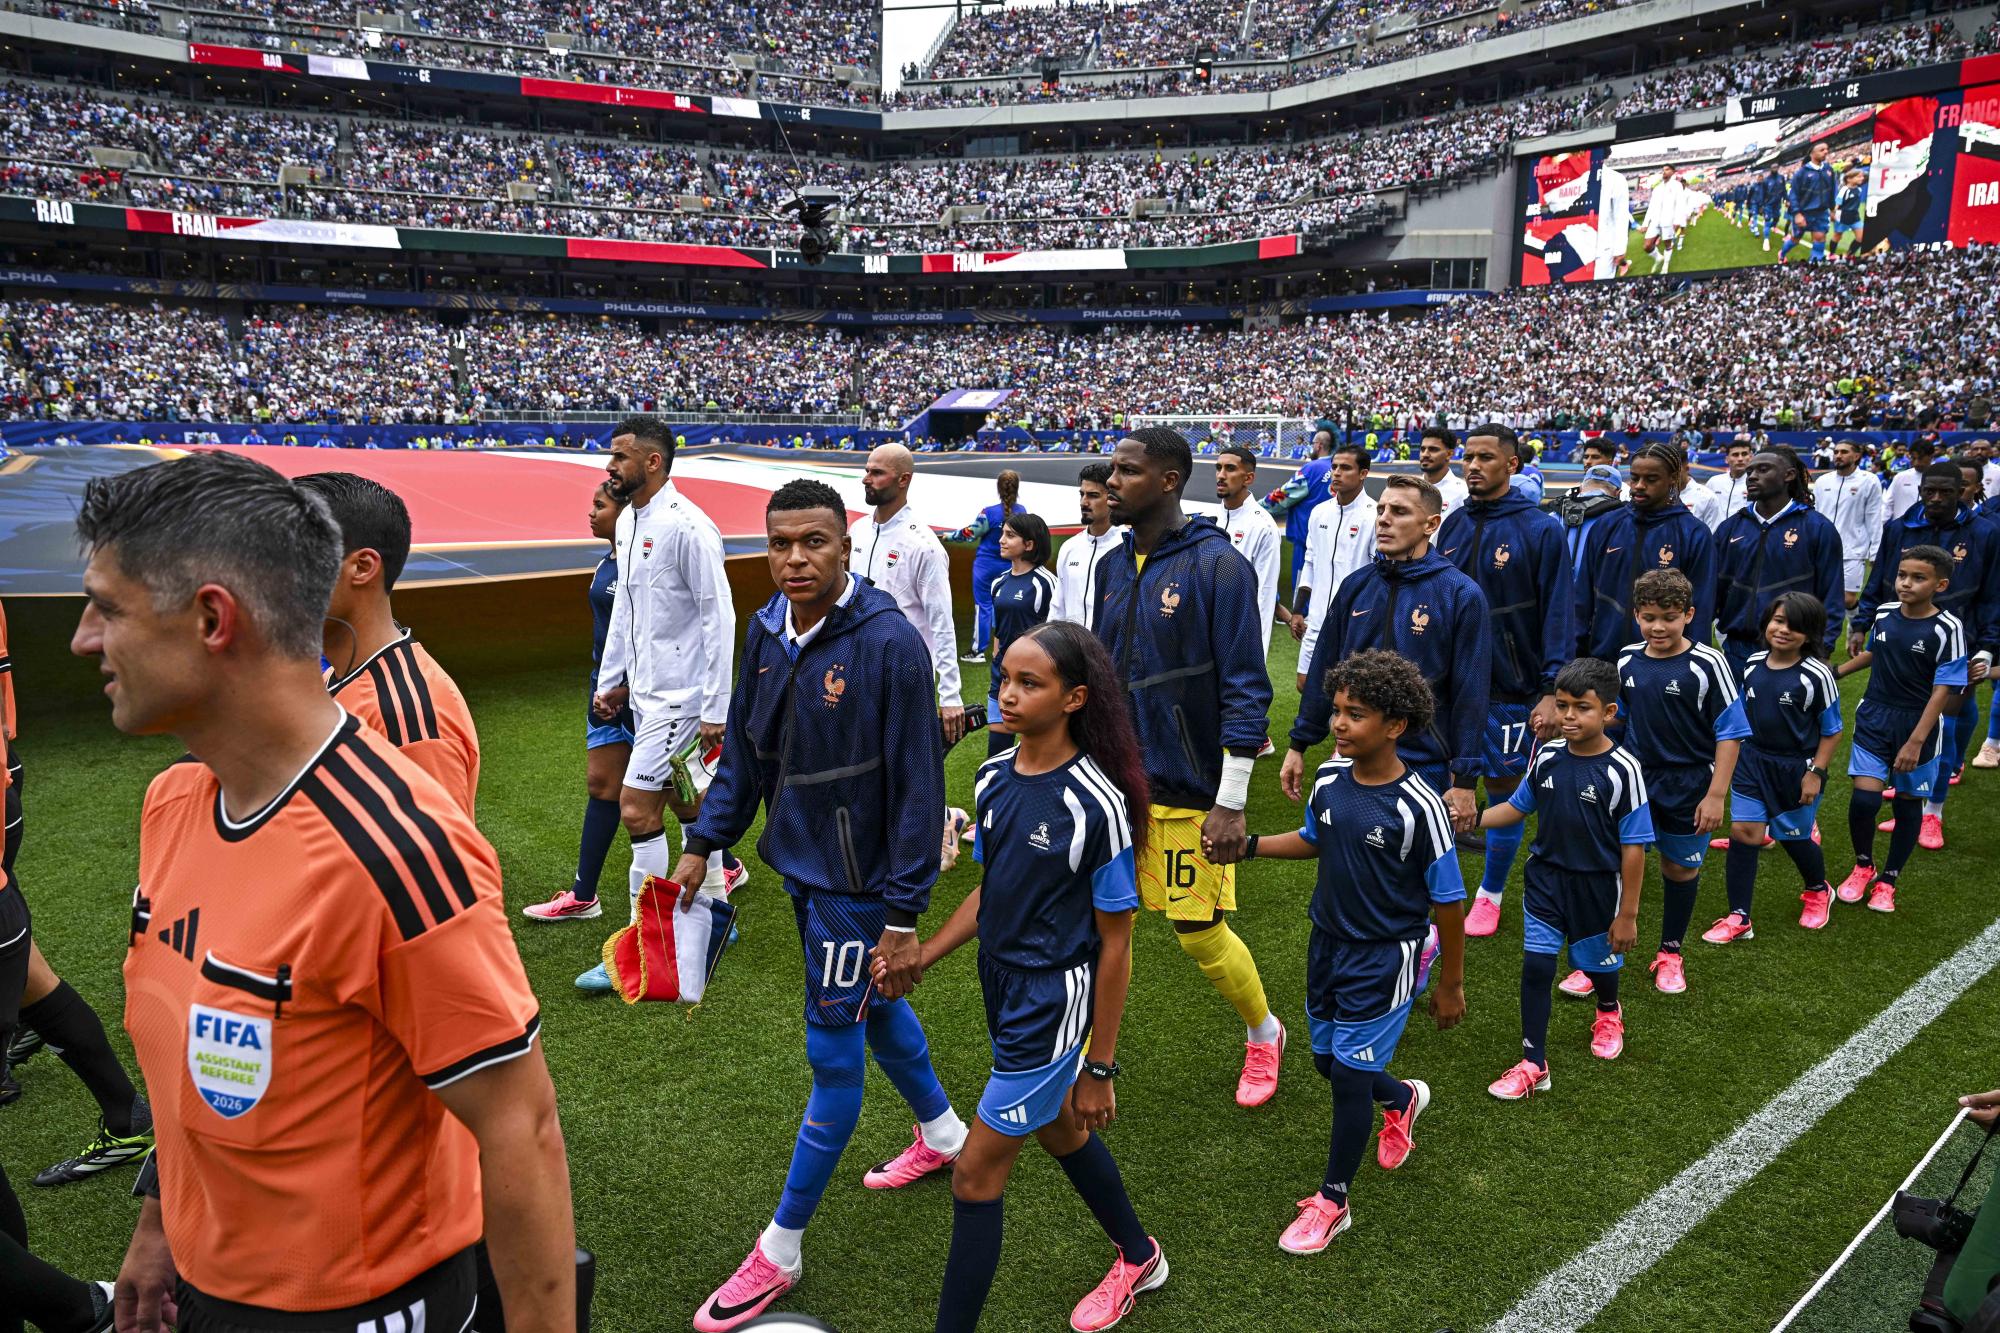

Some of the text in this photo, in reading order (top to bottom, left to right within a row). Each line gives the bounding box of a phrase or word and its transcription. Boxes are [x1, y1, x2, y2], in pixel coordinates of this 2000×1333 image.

[263, 54, 283, 68] RAQ
[418, 69, 431, 83] CE
[1846, 83, 1860, 99] CE
[674, 95, 691, 109] RAQ
[1751, 97, 1776, 114] FRAN
[801, 108, 811, 121] CE
[1967, 181, 1999, 208] IRA
[36, 200, 75, 225] RAQ
[172, 213, 217, 238] FRAN
[864, 255, 889, 273] RAQ
[953, 253, 984, 272] FRAN
[604, 303, 706, 315] PHILADELPHIA
[837, 312, 943, 321] FIFA WORLD CUP 2026
[1083, 309, 1181, 318] PHILADELPHIA
[1501, 722, 1526, 754] 17
[636, 773, 655, 783] JAKO
[1164, 849, 1196, 888] 16
[822, 941, 865, 988] 10
[196, 1013, 262, 1051] FIFA
[196, 1052, 261, 1073] ASSISTANT
[201, 1065, 255, 1085] REFEREE
[213, 1094, 243, 1111] 2026
